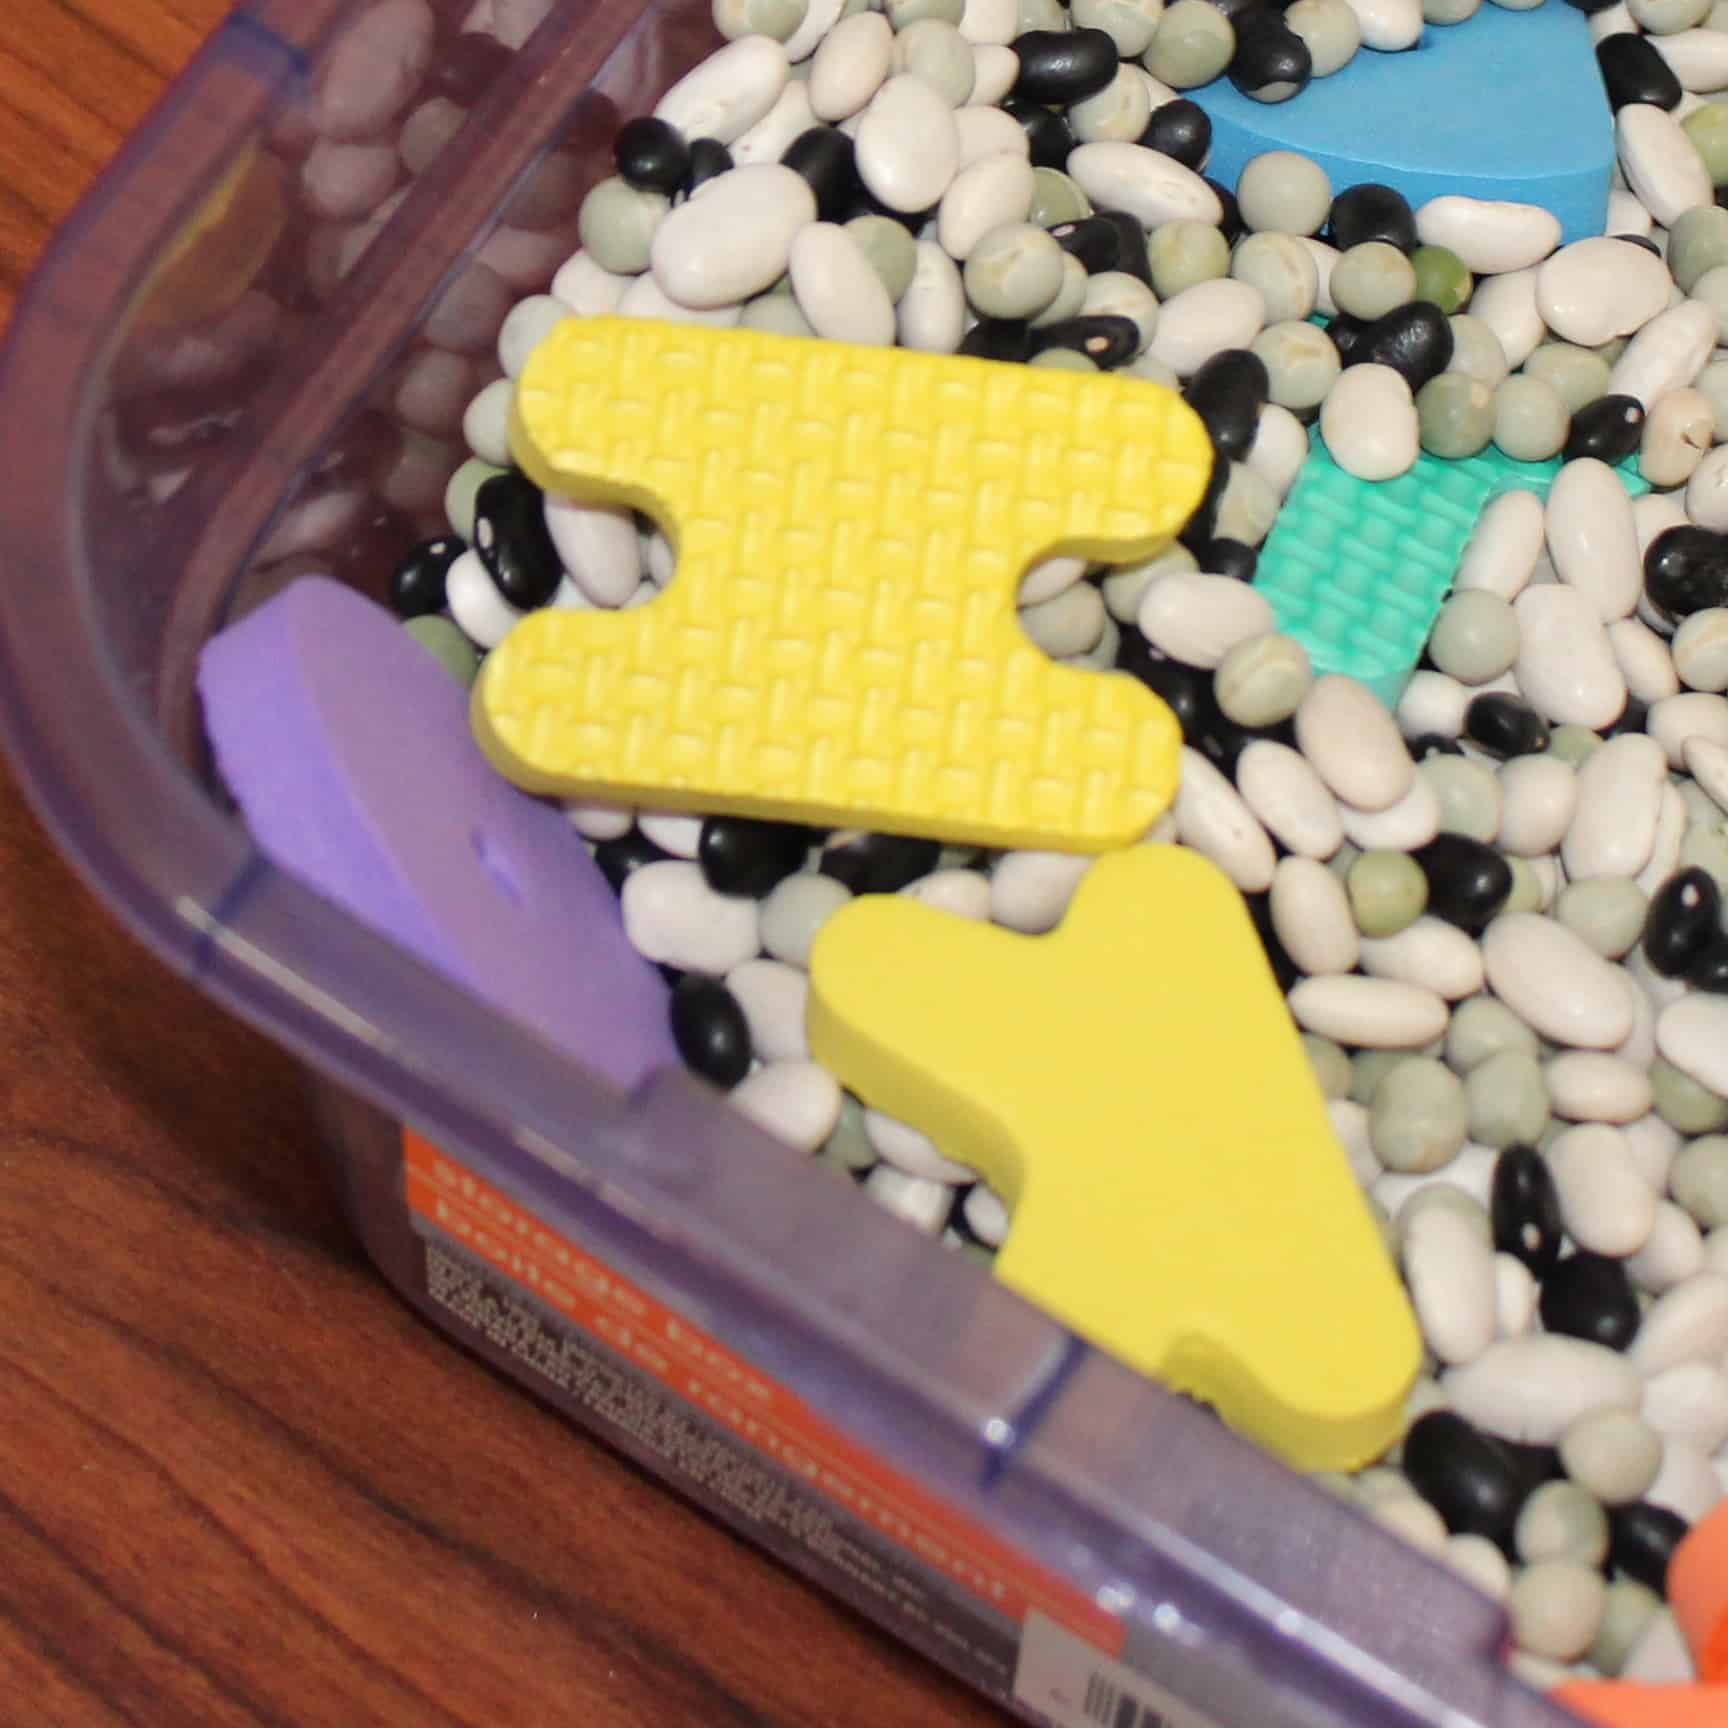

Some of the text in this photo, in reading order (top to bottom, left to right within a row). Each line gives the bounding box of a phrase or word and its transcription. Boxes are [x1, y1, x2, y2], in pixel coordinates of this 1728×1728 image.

[431, 1158, 771, 1400] storage box
[590, 1314, 670, 1374] de
[682, 1375, 1008, 1604] rangement
